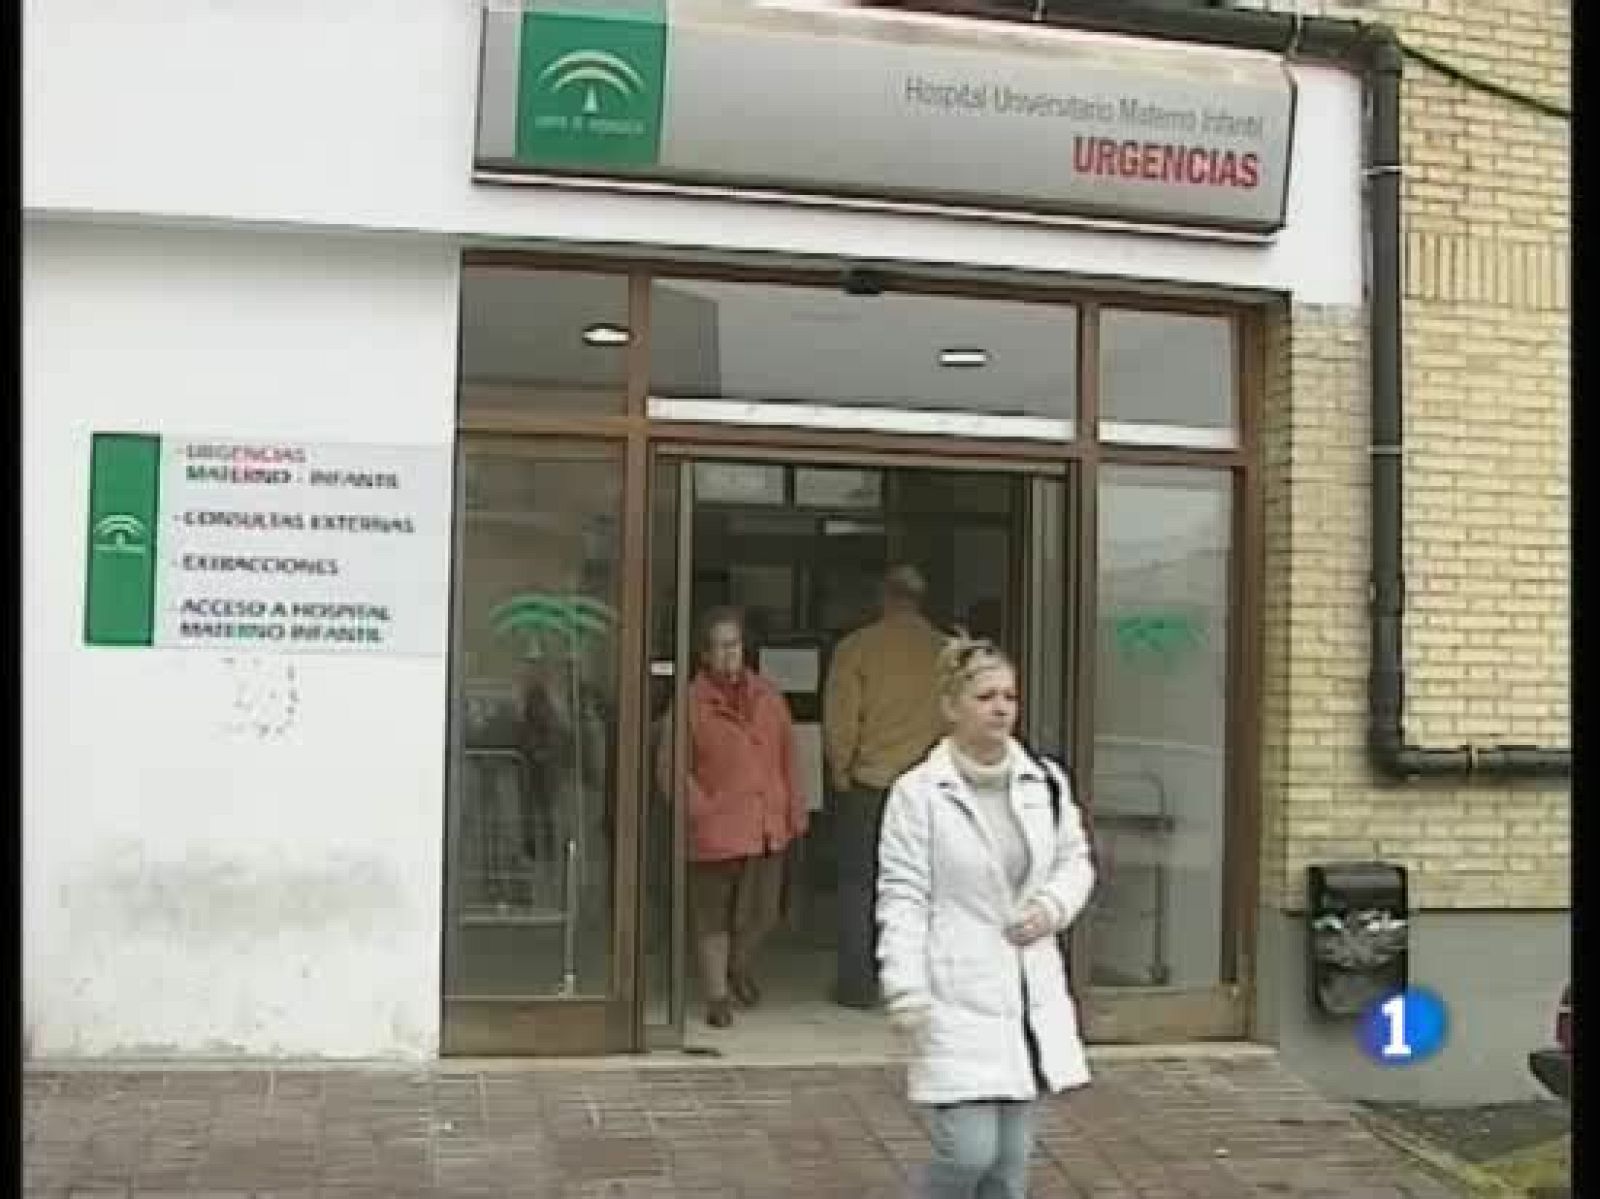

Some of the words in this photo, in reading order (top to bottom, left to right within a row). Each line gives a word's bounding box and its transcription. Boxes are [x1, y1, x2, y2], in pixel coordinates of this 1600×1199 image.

[1073, 135, 1260, 188] URGENCIAS
[180, 599, 267, 618] ACCESO
[270, 600, 286, 618] A
[292, 601, 391, 621] HOSPITAL
